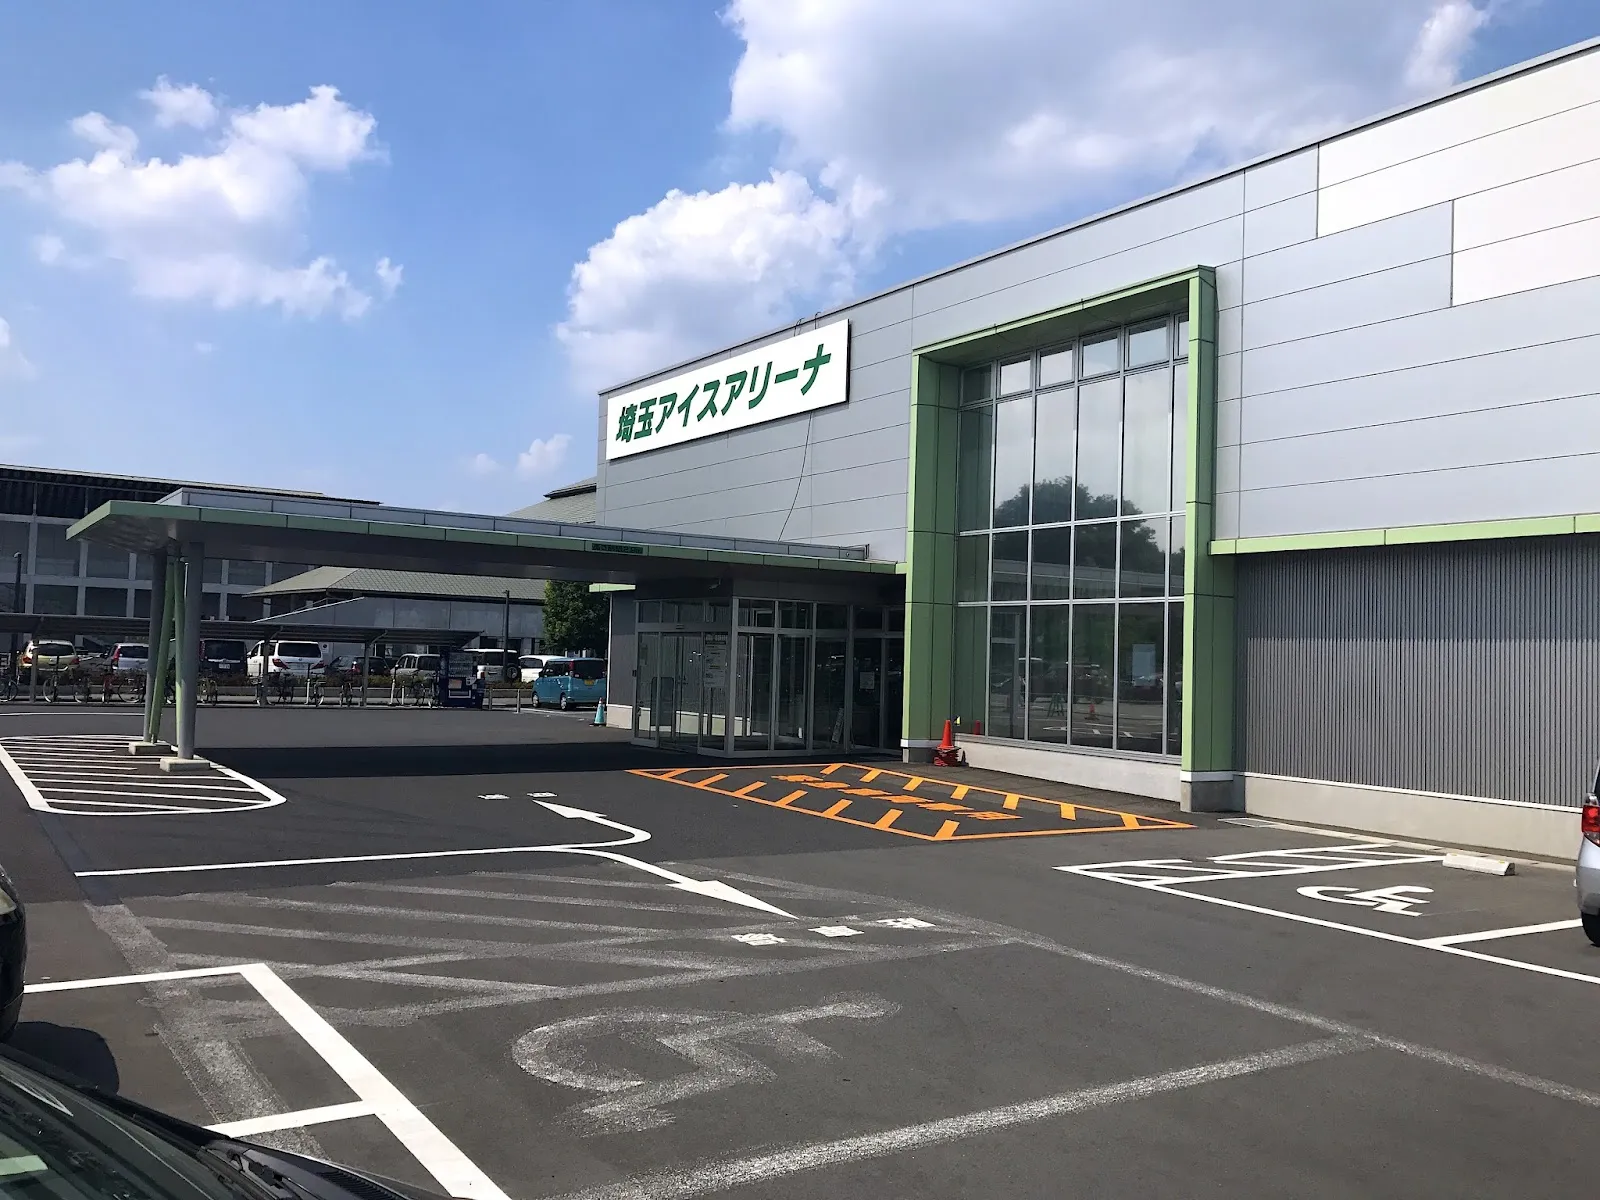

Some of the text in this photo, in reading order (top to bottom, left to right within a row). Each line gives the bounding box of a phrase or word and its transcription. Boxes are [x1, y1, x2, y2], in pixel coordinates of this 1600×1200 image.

[616, 343, 832, 443] 埼玉アイスアリーナ
